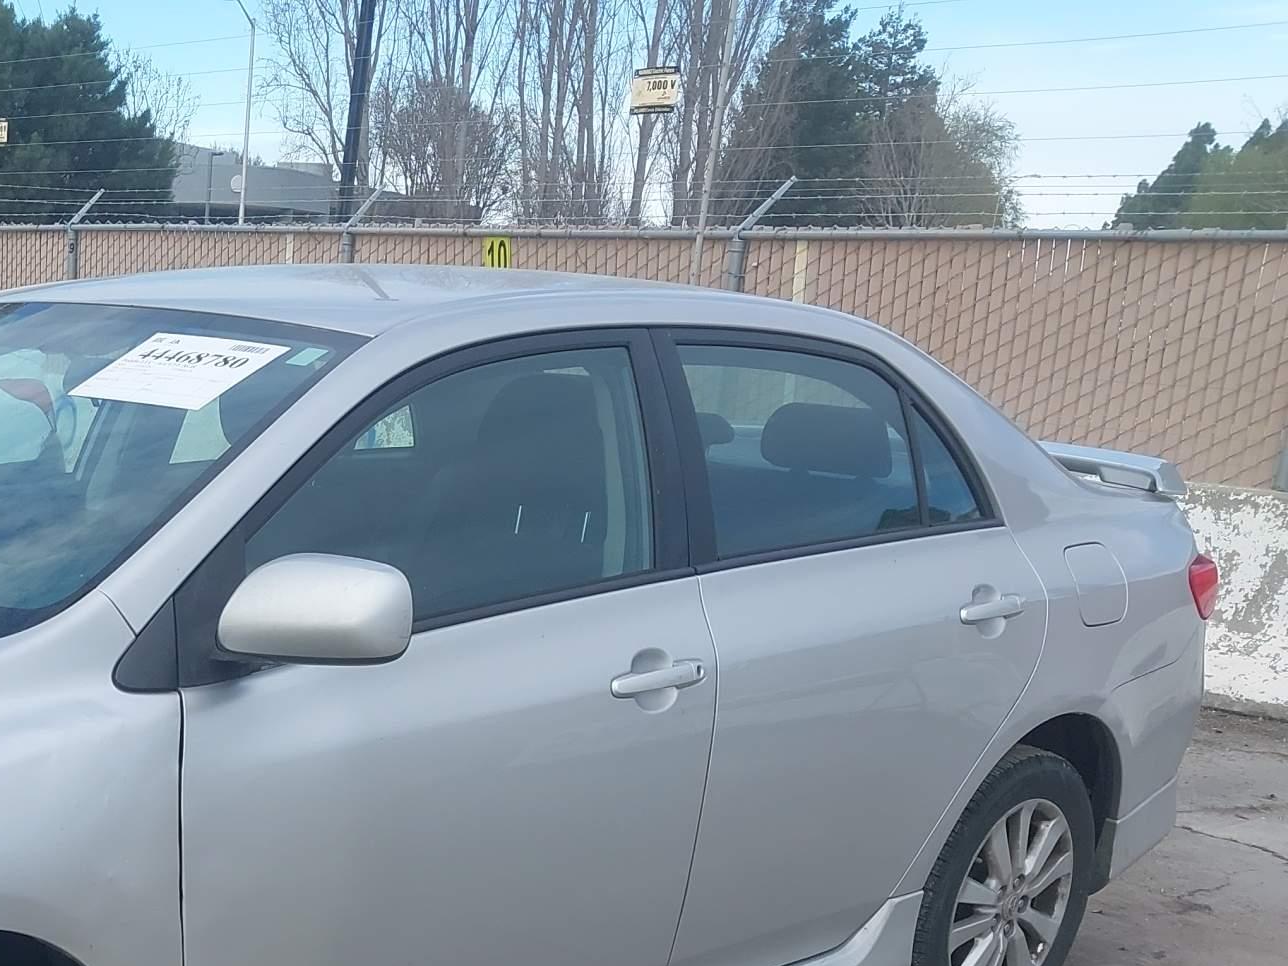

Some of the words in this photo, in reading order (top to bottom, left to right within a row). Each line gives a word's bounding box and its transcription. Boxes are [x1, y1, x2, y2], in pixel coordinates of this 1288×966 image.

[646, 79, 668, 92] 7,000
[670, 79, 677, 90] V
[487, 239, 508, 268] 10
[139, 348, 250, 369] 44468780
